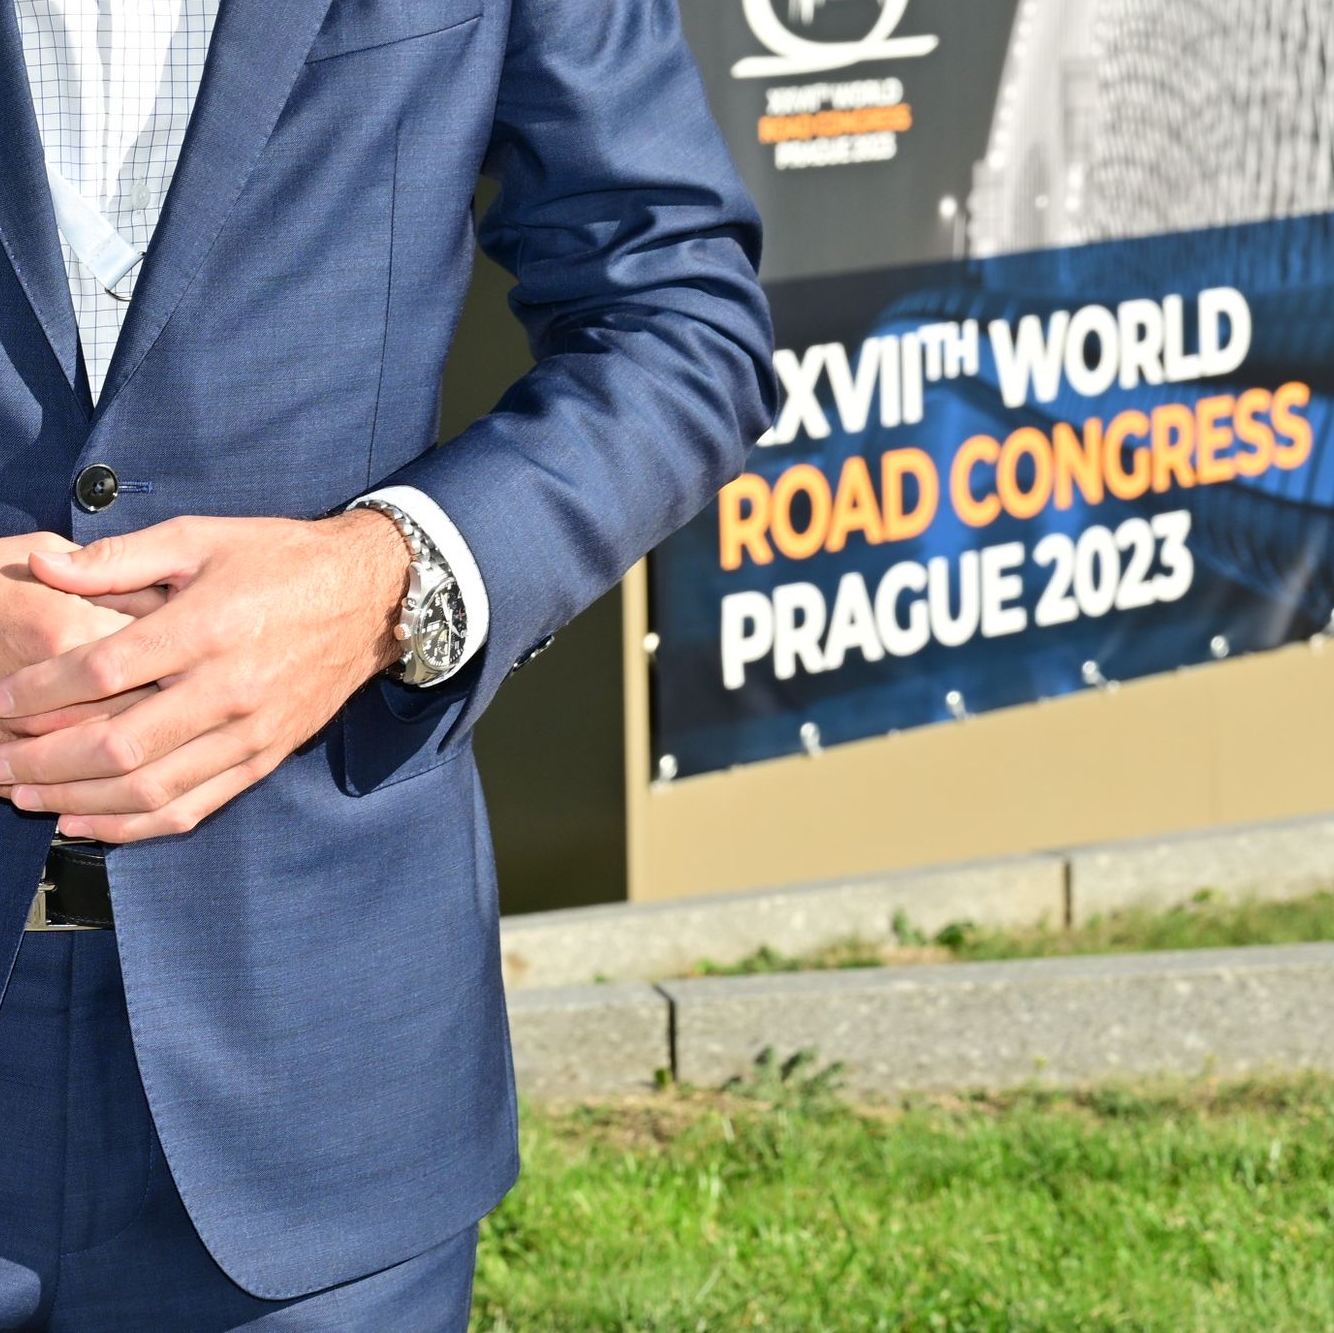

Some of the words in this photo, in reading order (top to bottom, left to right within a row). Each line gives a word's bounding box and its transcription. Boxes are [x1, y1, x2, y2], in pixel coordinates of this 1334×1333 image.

[988, 285, 1253, 409] WORLD
[717, 446, 941, 571] ROAD
[949, 380, 1313, 529] CONGRESS
[720, 540, 1029, 691] PRAGUE
[1032, 508, 1196, 628] 2023
